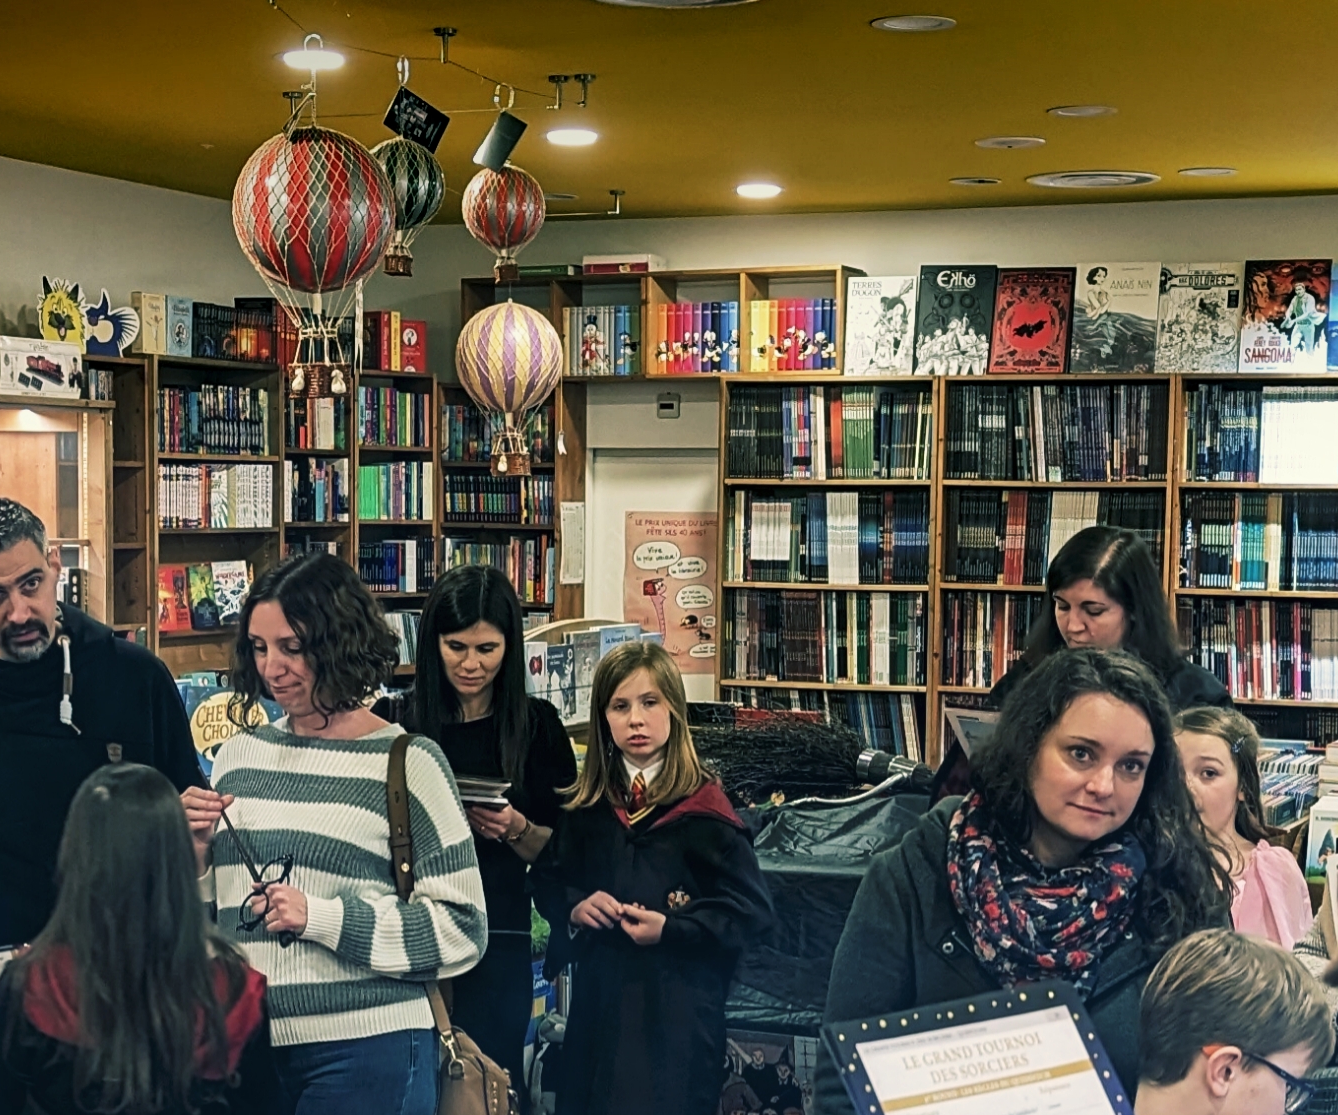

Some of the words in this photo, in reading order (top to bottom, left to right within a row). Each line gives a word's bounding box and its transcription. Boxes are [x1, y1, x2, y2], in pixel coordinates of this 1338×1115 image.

[852, 281, 882, 289] TERRES
[1137, 280, 1153, 290] NIN
[1188, 275, 1227, 286] DOLORES
[1244, 347, 1292, 364] SANGOMA
[902, 1055, 920, 1070] LE
[922, 1044, 972, 1067] GRAND
[970, 1032, 1042, 1058] TOURNOI
[930, 1068, 959, 1084] DES
[959, 1053, 1029, 1079] SORCIERS
